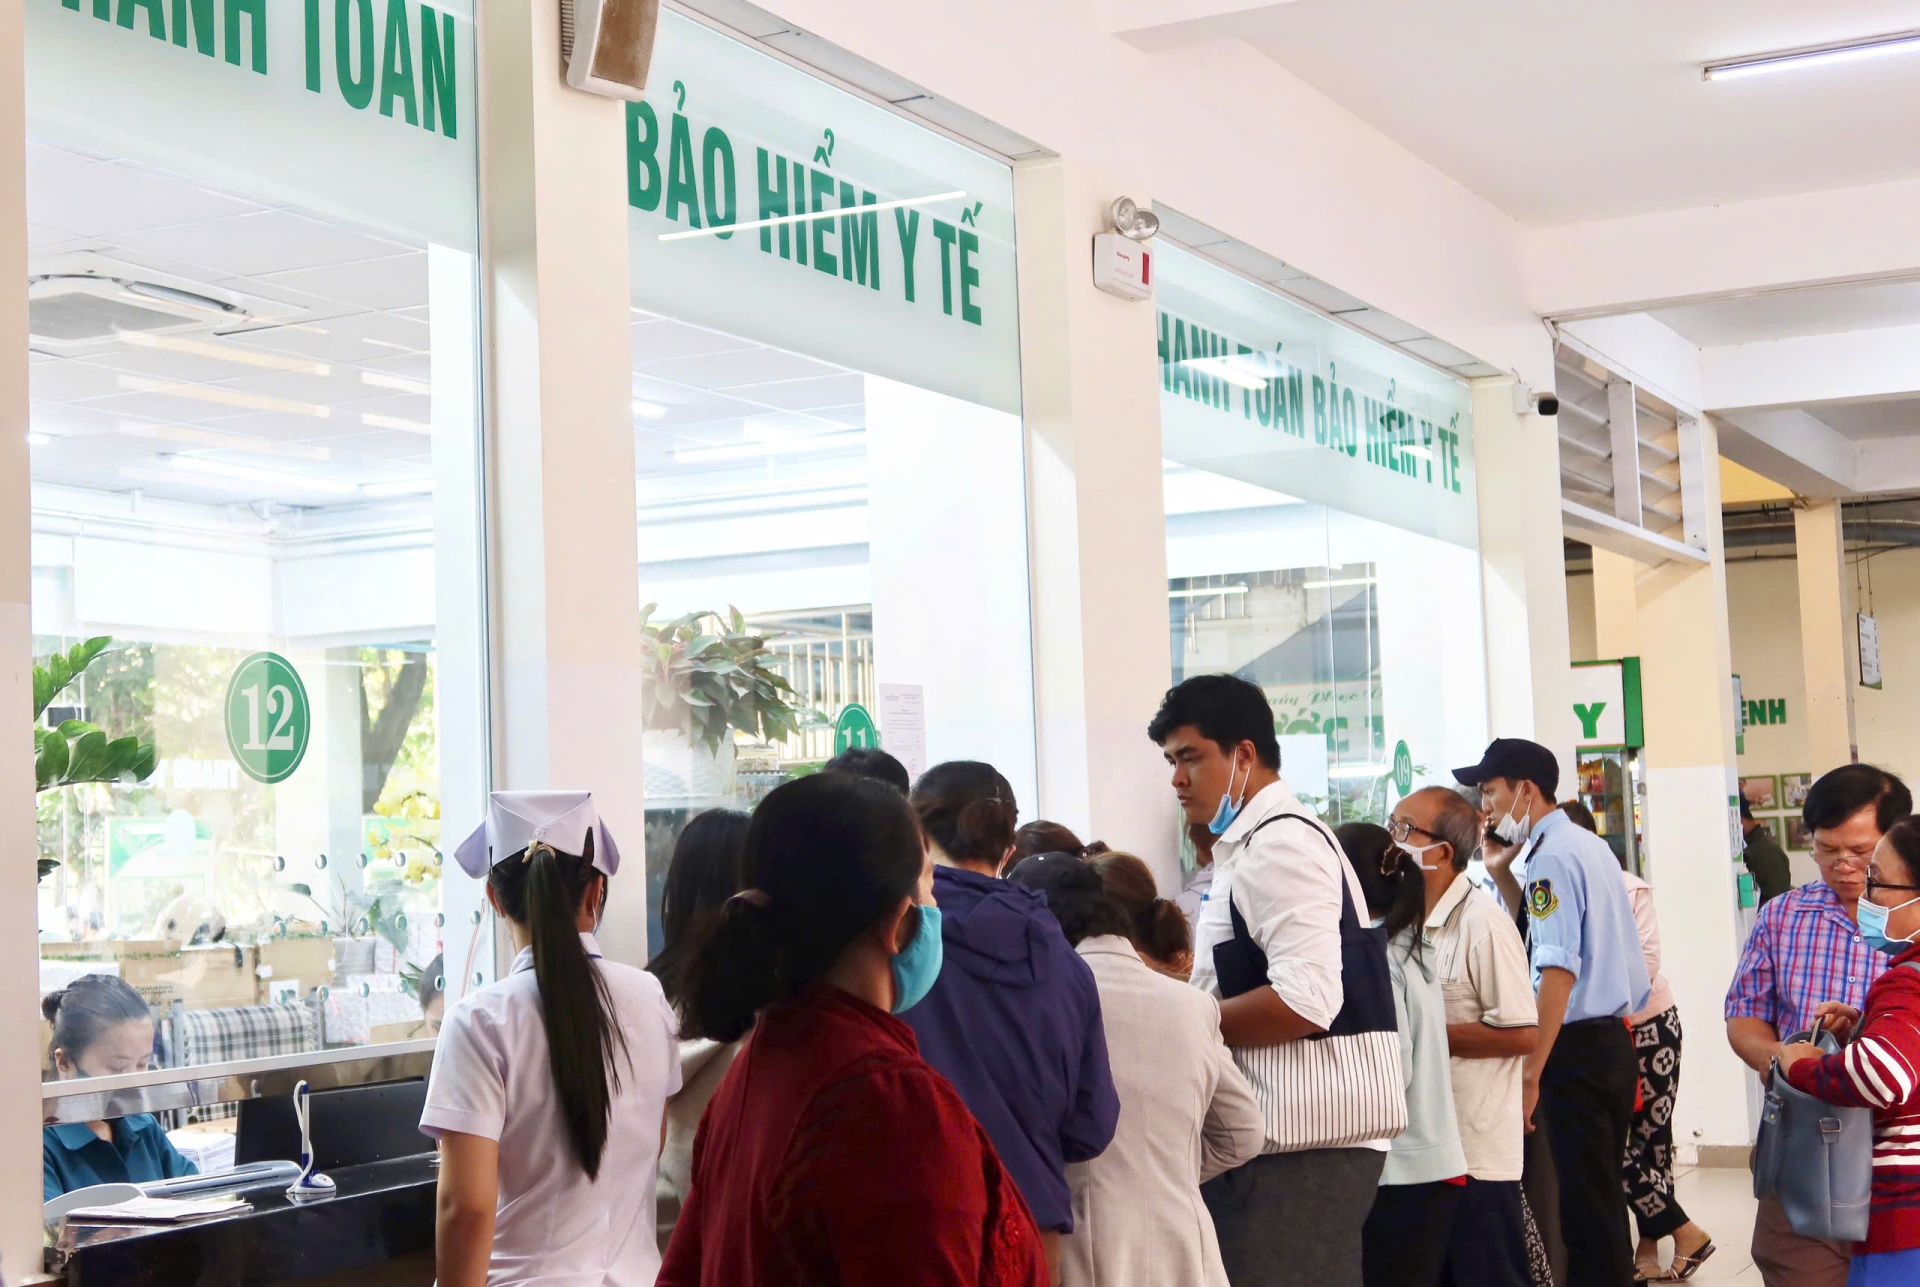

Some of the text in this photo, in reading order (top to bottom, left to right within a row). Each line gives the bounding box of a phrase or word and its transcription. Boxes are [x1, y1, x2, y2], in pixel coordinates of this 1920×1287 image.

[624, 80, 982, 326] BẢO HIỂM Y TẾ
[1312, 361, 1358, 458] BẢO
[1364, 378, 1418, 479] HIỂM
[1421, 419, 1433, 484] Y
[1437, 412, 1462, 494] TẾ
[240, 684, 295, 751] 12
[841, 725, 867, 749] 11
[1573, 702, 1607, 739] Y
[1397, 755, 1410, 786] 09
